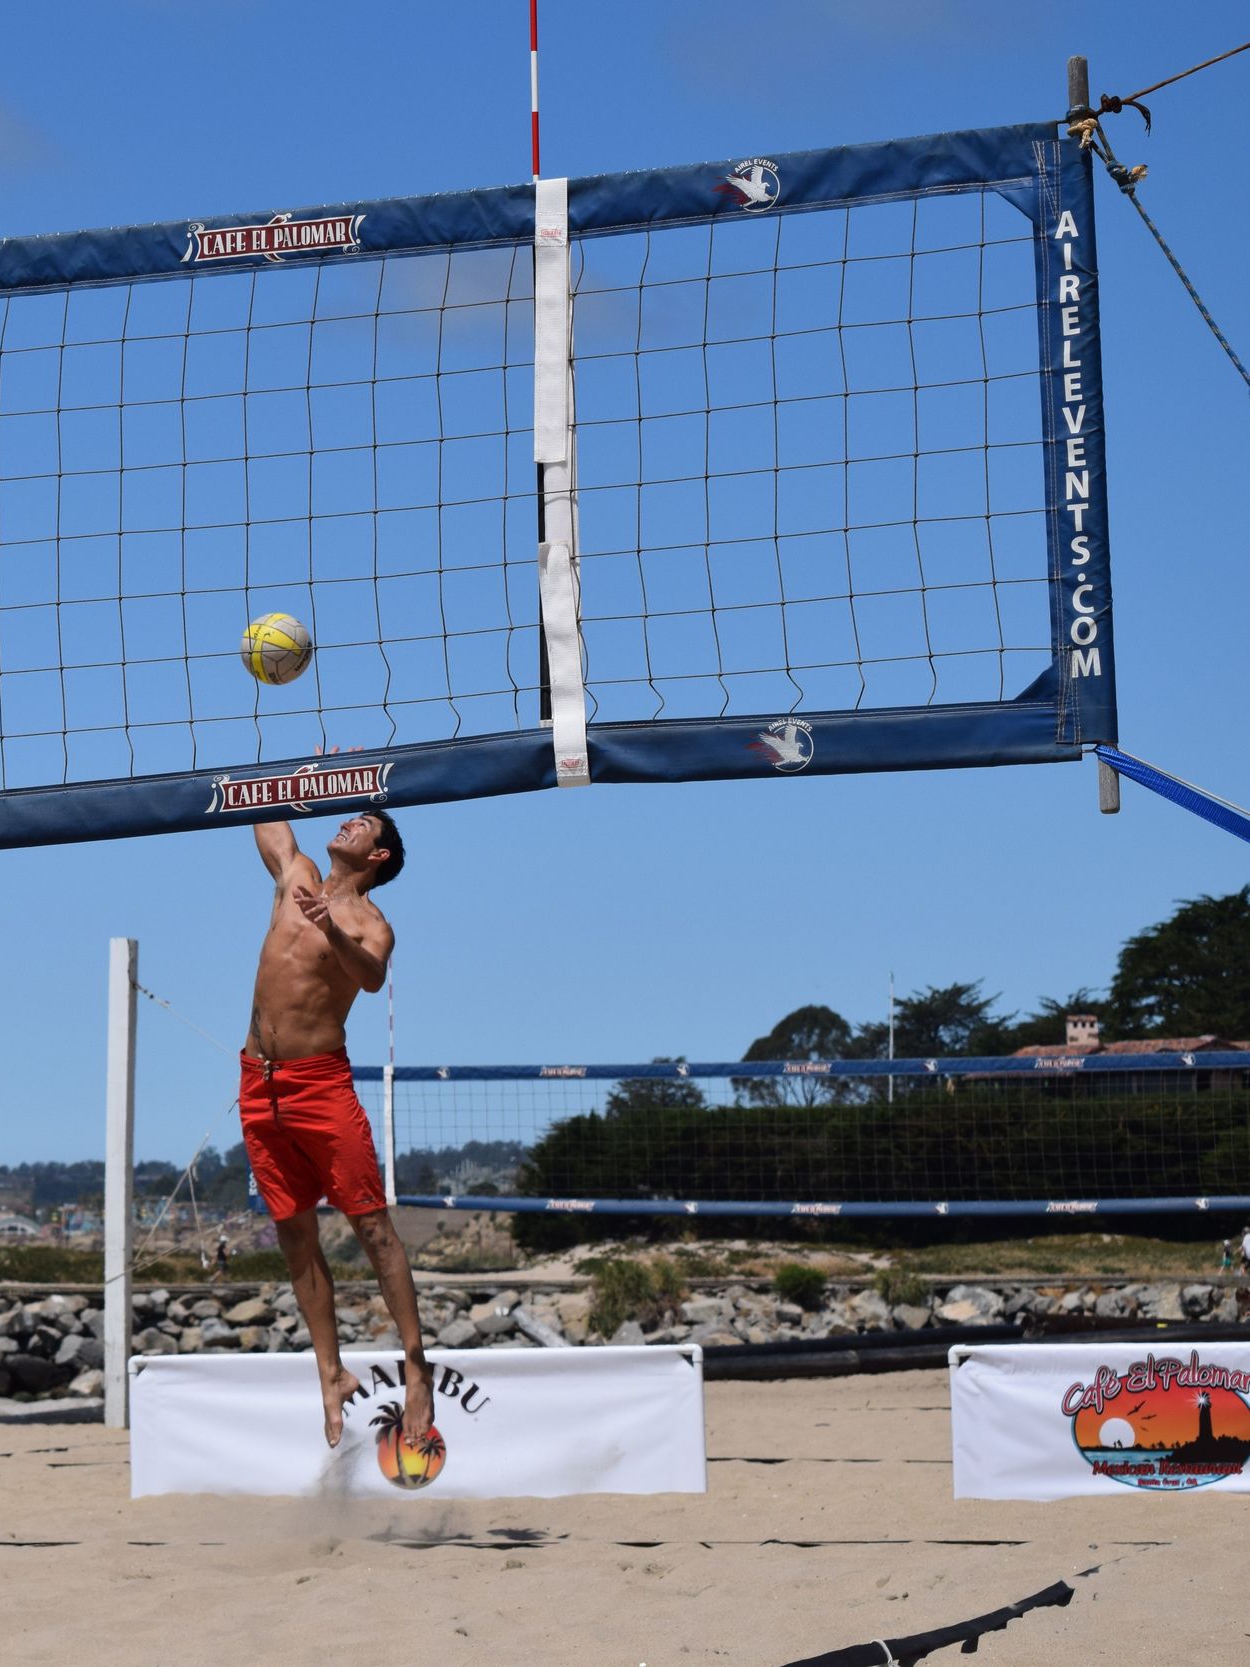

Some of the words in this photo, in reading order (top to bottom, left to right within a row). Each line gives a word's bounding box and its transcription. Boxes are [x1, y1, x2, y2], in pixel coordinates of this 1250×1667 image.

[735, 160, 753, 173] AIREL
[754, 159, 779, 172] EVENTS
[203, 231, 246, 256] CAFE
[252, 229, 270, 250] EL
[273, 221, 346, 248] PALOMAR
[1055, 210, 1102, 679] AIRELEVENTS.COM
[788, 717, 813, 732] EVENTS
[227, 782, 272, 806] CAFE
[278, 780, 296, 800] EL
[300, 770, 373, 798] PALOMAR
[1061, 1365, 1122, 1416] Café
[1126, 1352, 1157, 1392] El
[1155, 1349, 1250, 1394] Palomar
